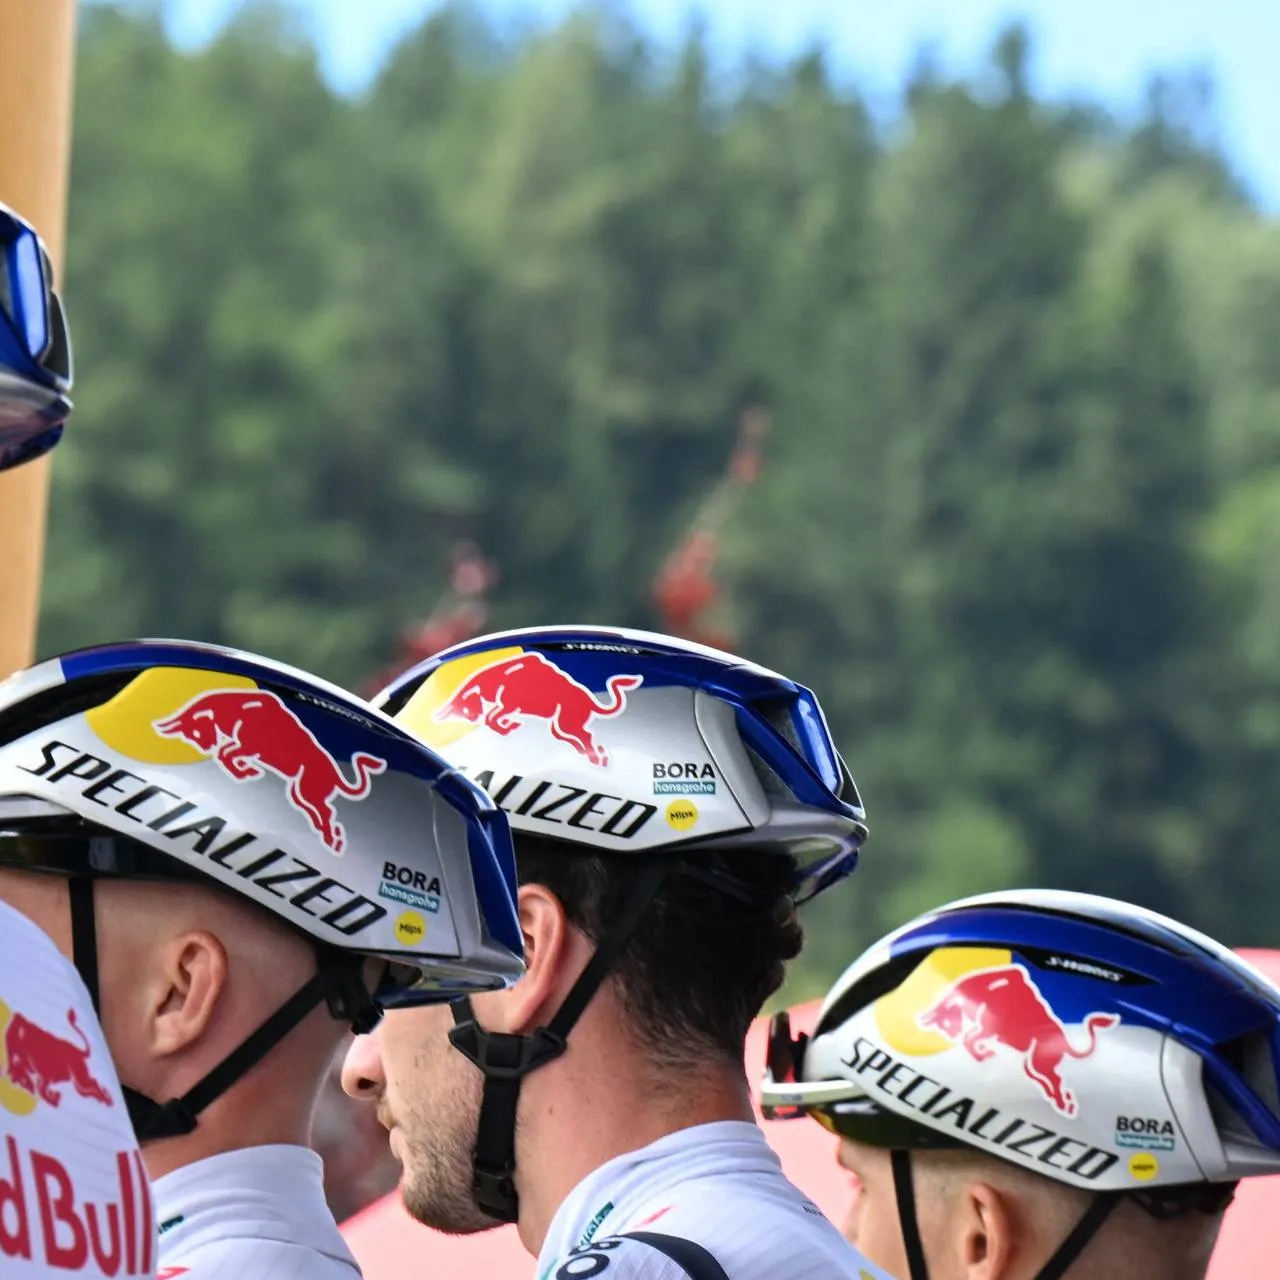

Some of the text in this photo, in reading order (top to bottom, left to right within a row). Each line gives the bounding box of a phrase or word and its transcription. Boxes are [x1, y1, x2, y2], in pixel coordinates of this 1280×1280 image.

[652, 762, 716, 779] BORA
[18, 739, 387, 936] SPECIALIZED
[382, 860, 442, 897] BORA
[841, 1037, 1120, 1181] SPECIALIZED
[1116, 1115, 1175, 1136] BORA
